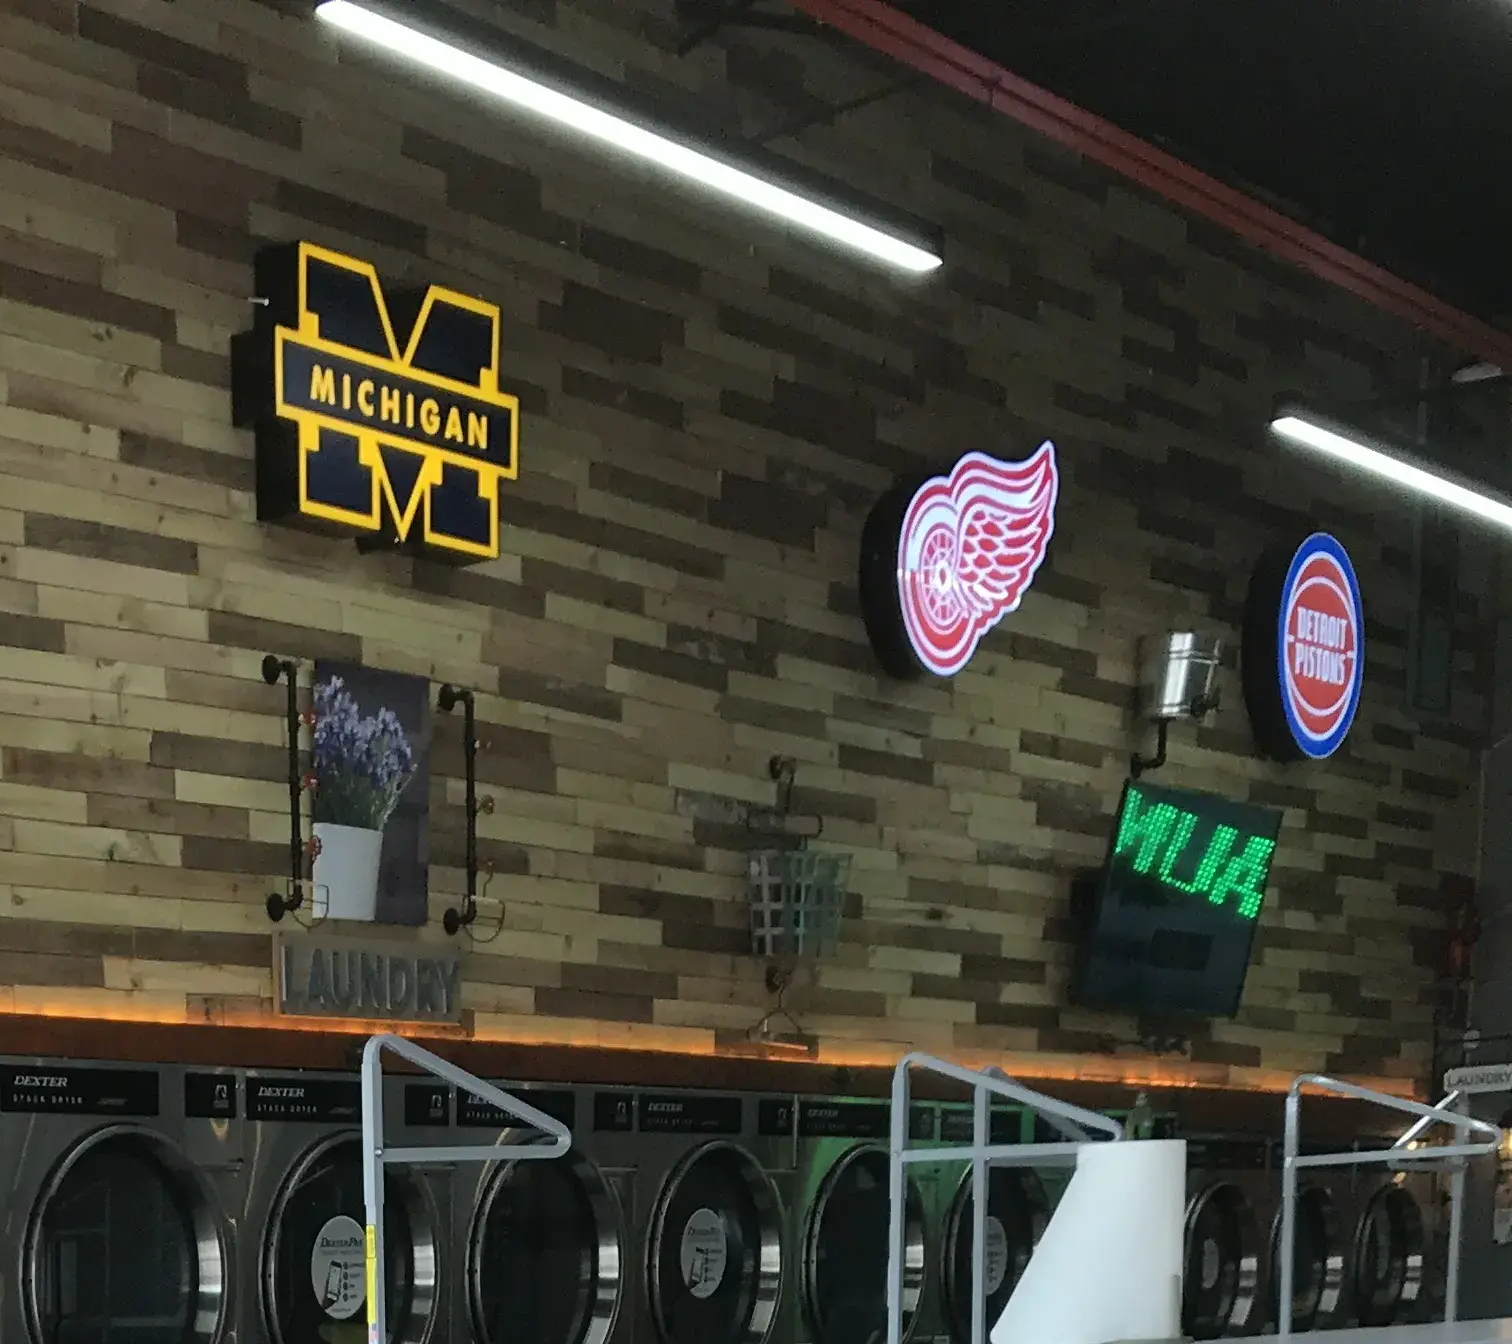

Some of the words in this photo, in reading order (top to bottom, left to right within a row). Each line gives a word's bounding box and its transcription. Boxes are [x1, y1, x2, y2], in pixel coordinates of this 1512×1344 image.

[309, 363, 489, 450] MICHIGAN
[1297, 605, 1347, 650] DETROIT
[1294, 642, 1346, 685] PISTONS
[280, 945, 460, 1015] LAUNDRY
[13, 1075, 68, 1087] DEXTER
[257, 1086, 305, 1098] DEXTER
[1446, 1070, 1512, 1087] LAUNDRY
